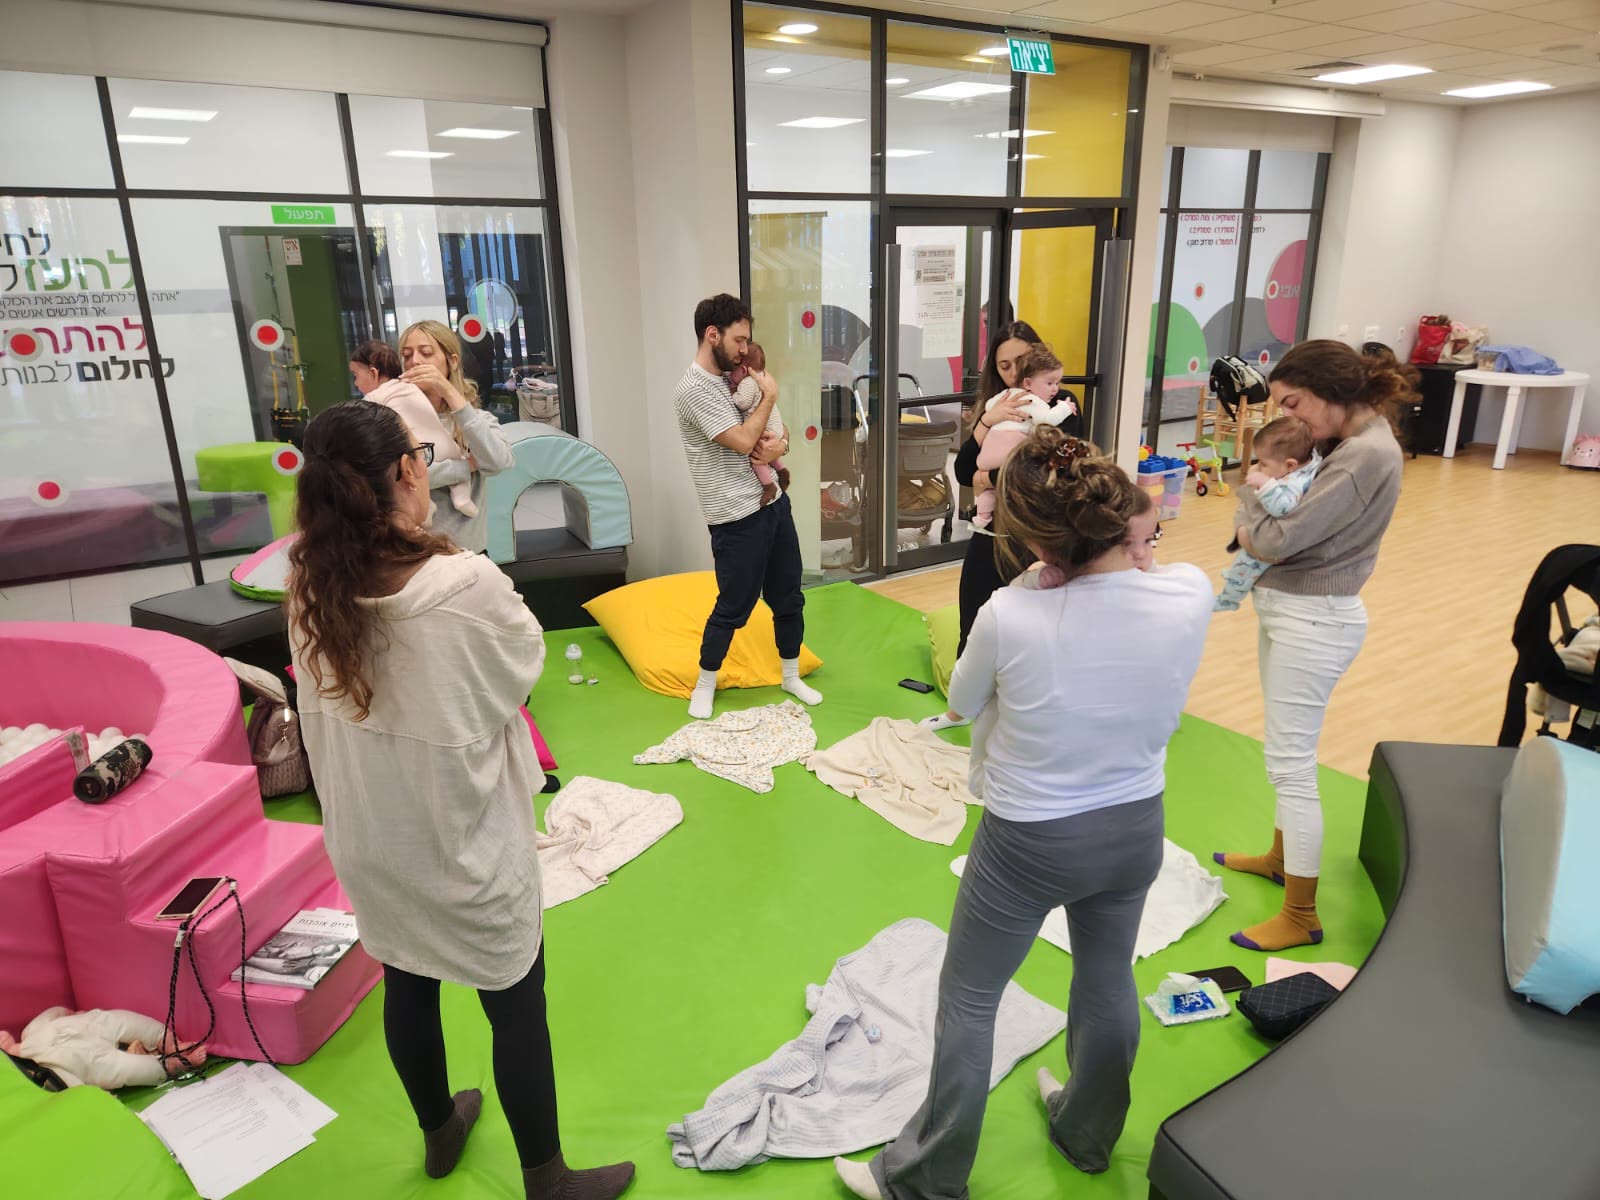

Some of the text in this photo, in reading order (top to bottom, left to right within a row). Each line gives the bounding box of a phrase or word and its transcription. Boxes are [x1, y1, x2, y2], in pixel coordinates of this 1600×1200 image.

[1012, 40, 1050, 71] יציאה
[283, 207, 325, 220] תפעול
[0, 227, 51, 256] לח
[35, 295, 53, 305] את
[55, 294, 90, 305] ולעצב
[92, 292, 127, 304] לחלום
[8, 309, 44, 318] אנשים
[47, 307, 88, 317] נדרשים
[91, 306, 107, 317] אך
[1, 354, 175, 386] לחלום לבנות
